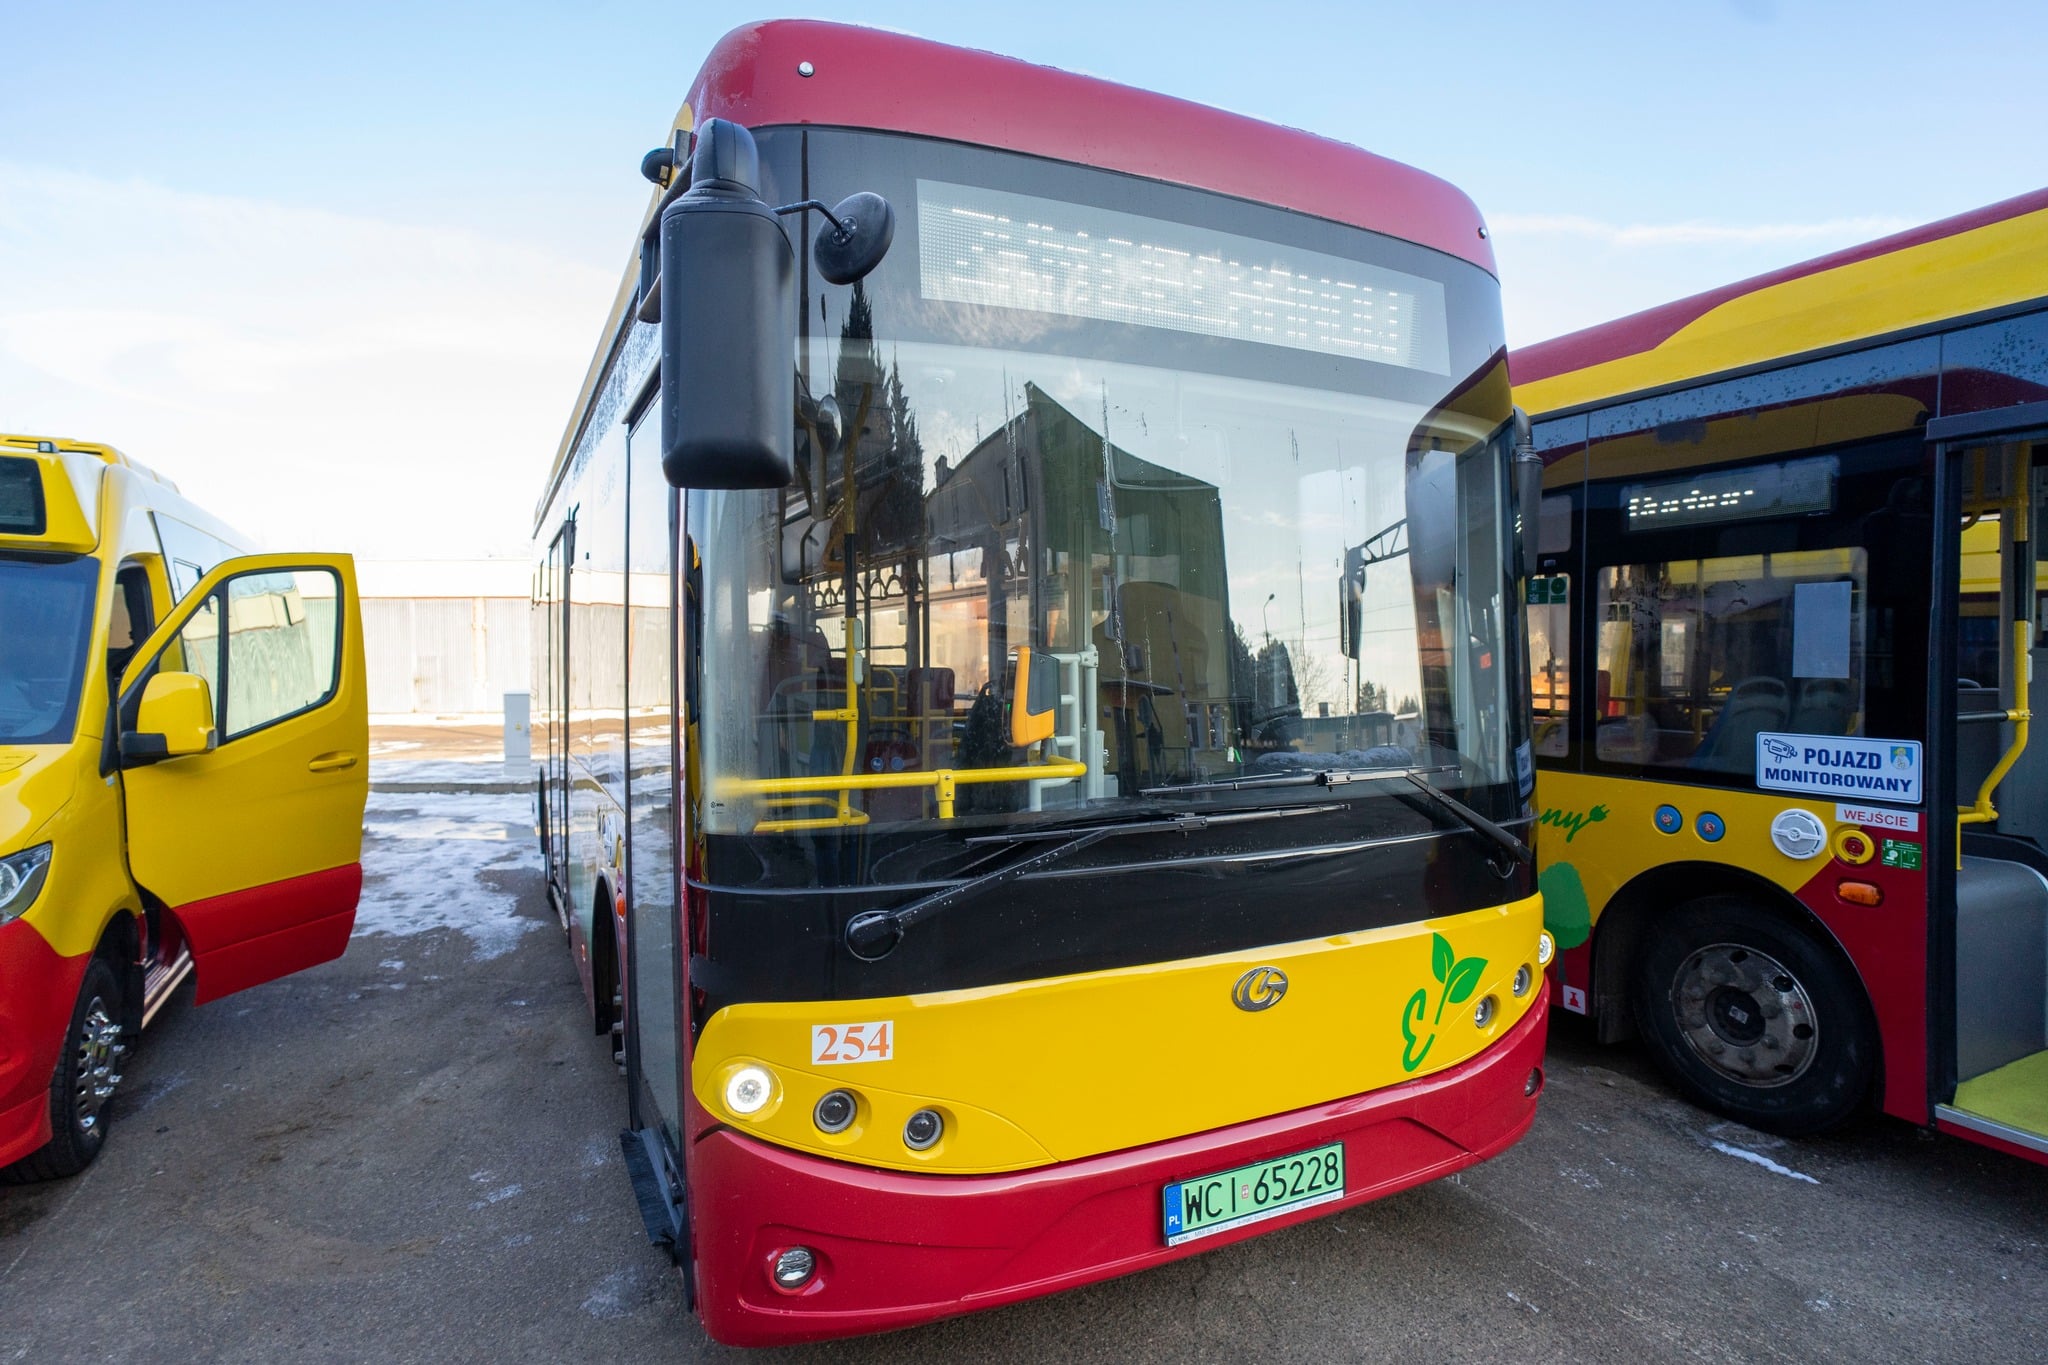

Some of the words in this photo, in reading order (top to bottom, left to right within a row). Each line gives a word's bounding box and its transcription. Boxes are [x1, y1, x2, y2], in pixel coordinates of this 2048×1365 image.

[1804, 748, 1882, 770] POJAZD
[1765, 767, 1913, 792] MONITOROWANY
[1844, 809, 1909, 827] WEJŚCIE
[817, 1023, 889, 1061] 254
[1185, 1177, 1236, 1225] WCI
[1254, 1152, 1339, 1205] 65228
[1168, 1215, 1180, 1226] PL
